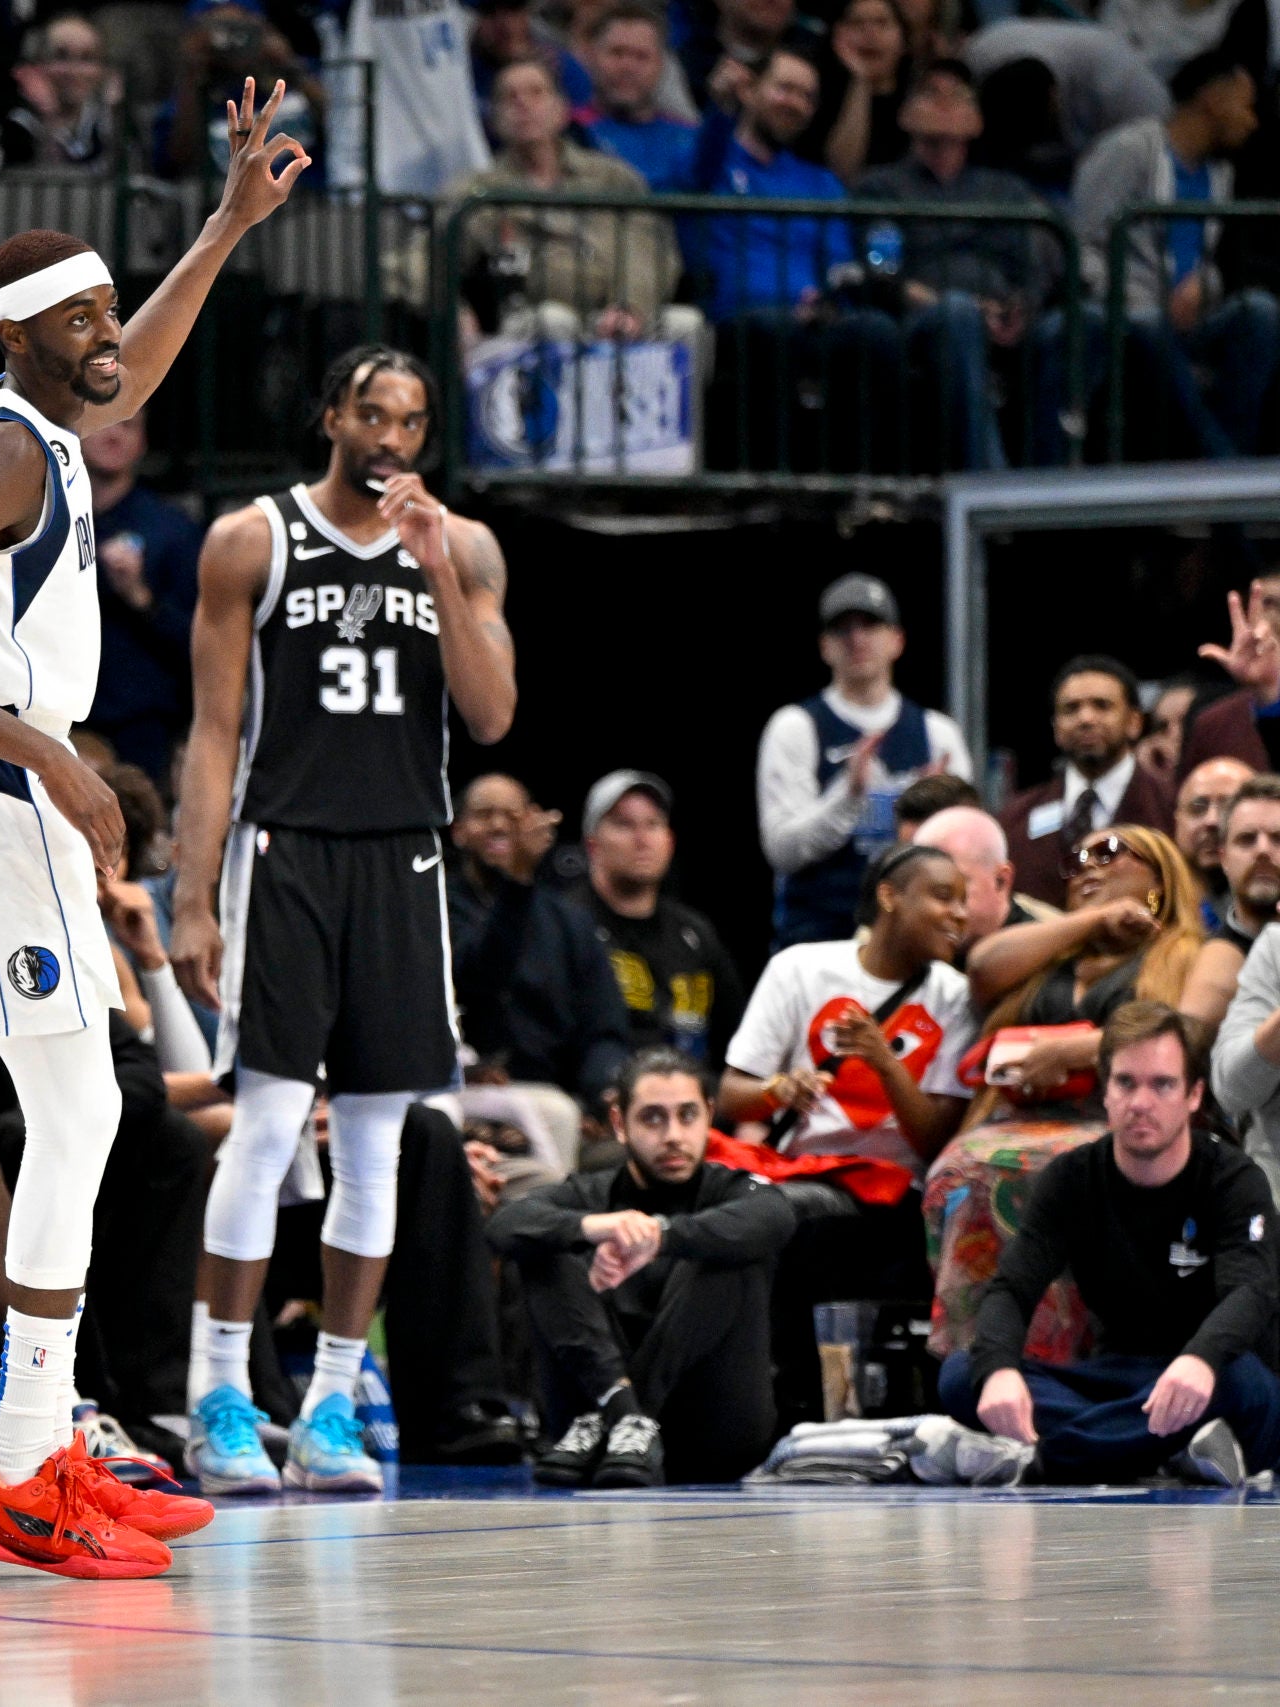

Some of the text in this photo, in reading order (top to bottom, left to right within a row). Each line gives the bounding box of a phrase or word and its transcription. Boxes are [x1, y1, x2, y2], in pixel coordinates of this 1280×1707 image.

[75, 512, 96, 572] DAL
[285, 583, 441, 645] SPURS
[320, 645, 405, 715] 31
